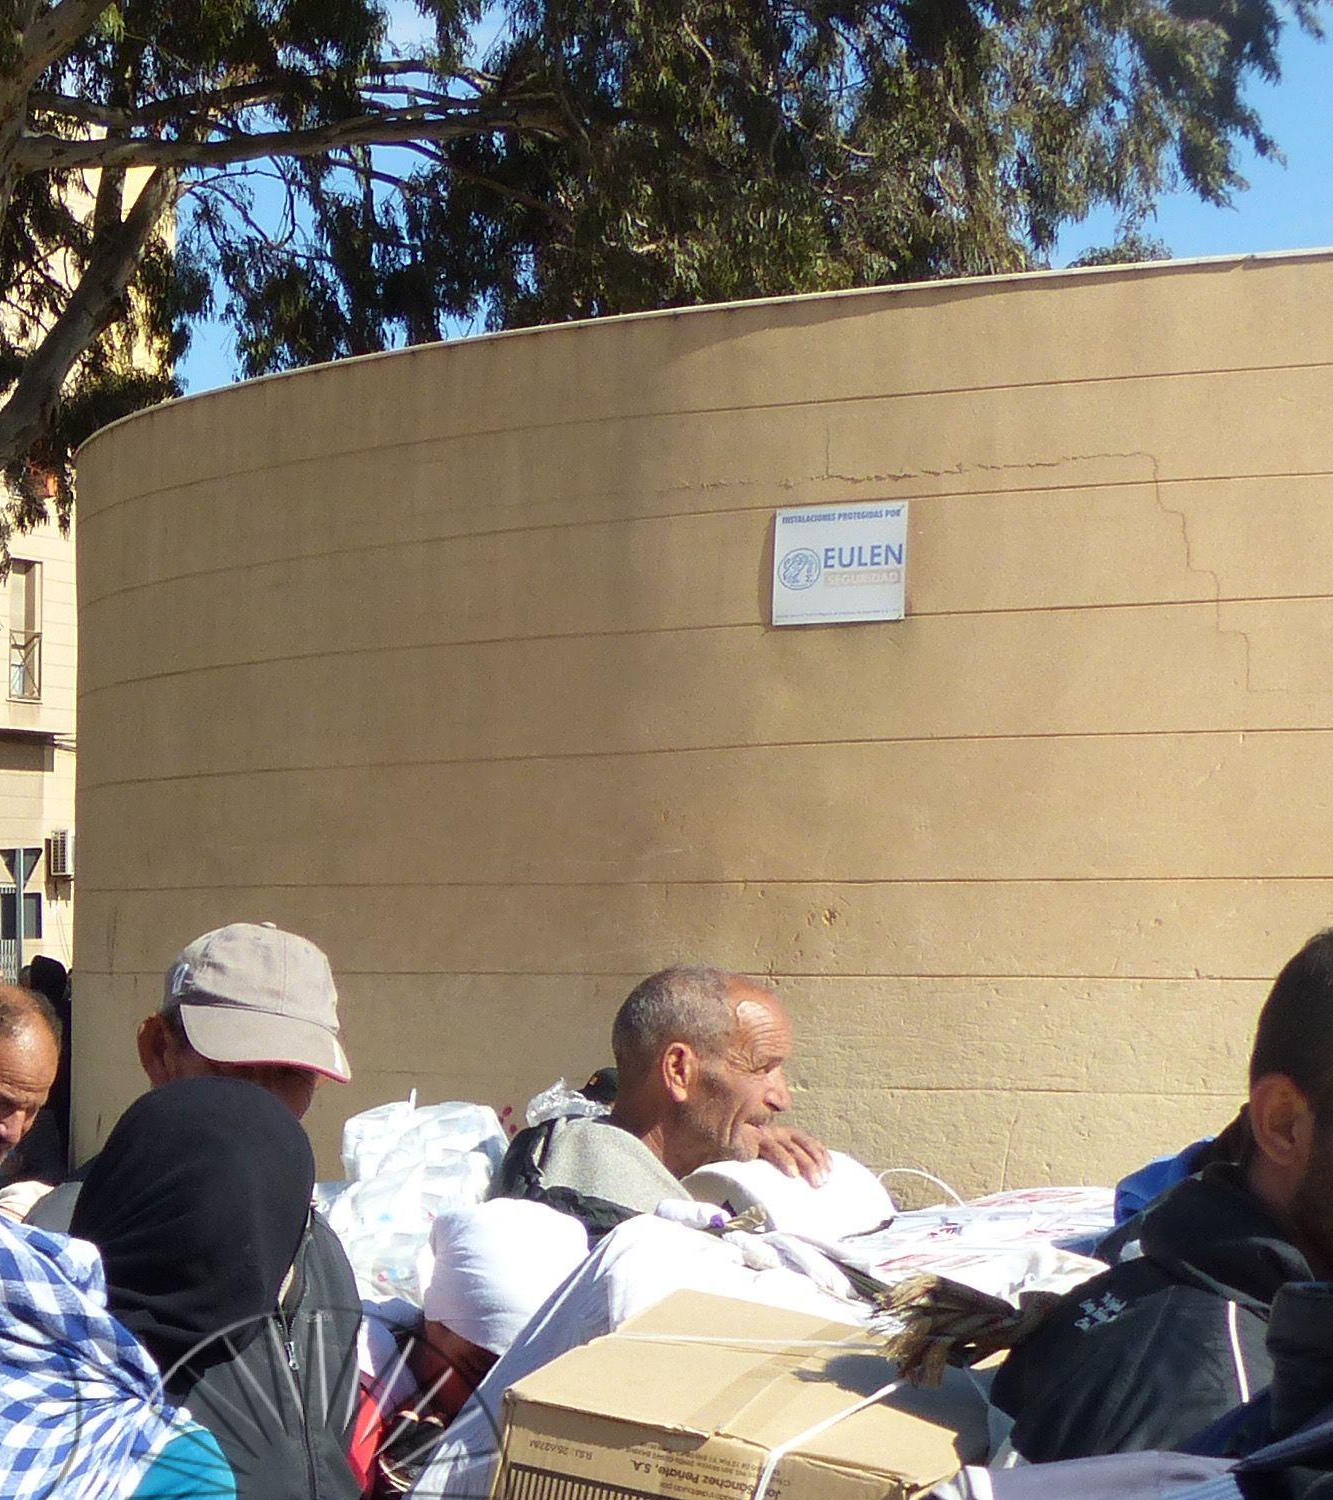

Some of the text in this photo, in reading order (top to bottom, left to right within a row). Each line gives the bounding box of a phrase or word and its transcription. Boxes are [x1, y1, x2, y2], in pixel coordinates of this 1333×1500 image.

[782, 508, 901, 525] INSTALACIONES PROTEGIDAS POR
[823, 543, 904, 569] EULEN
[826, 571, 899, 585] SEGURIDAD
[702, 1474, 755, 1496] Sánchez
